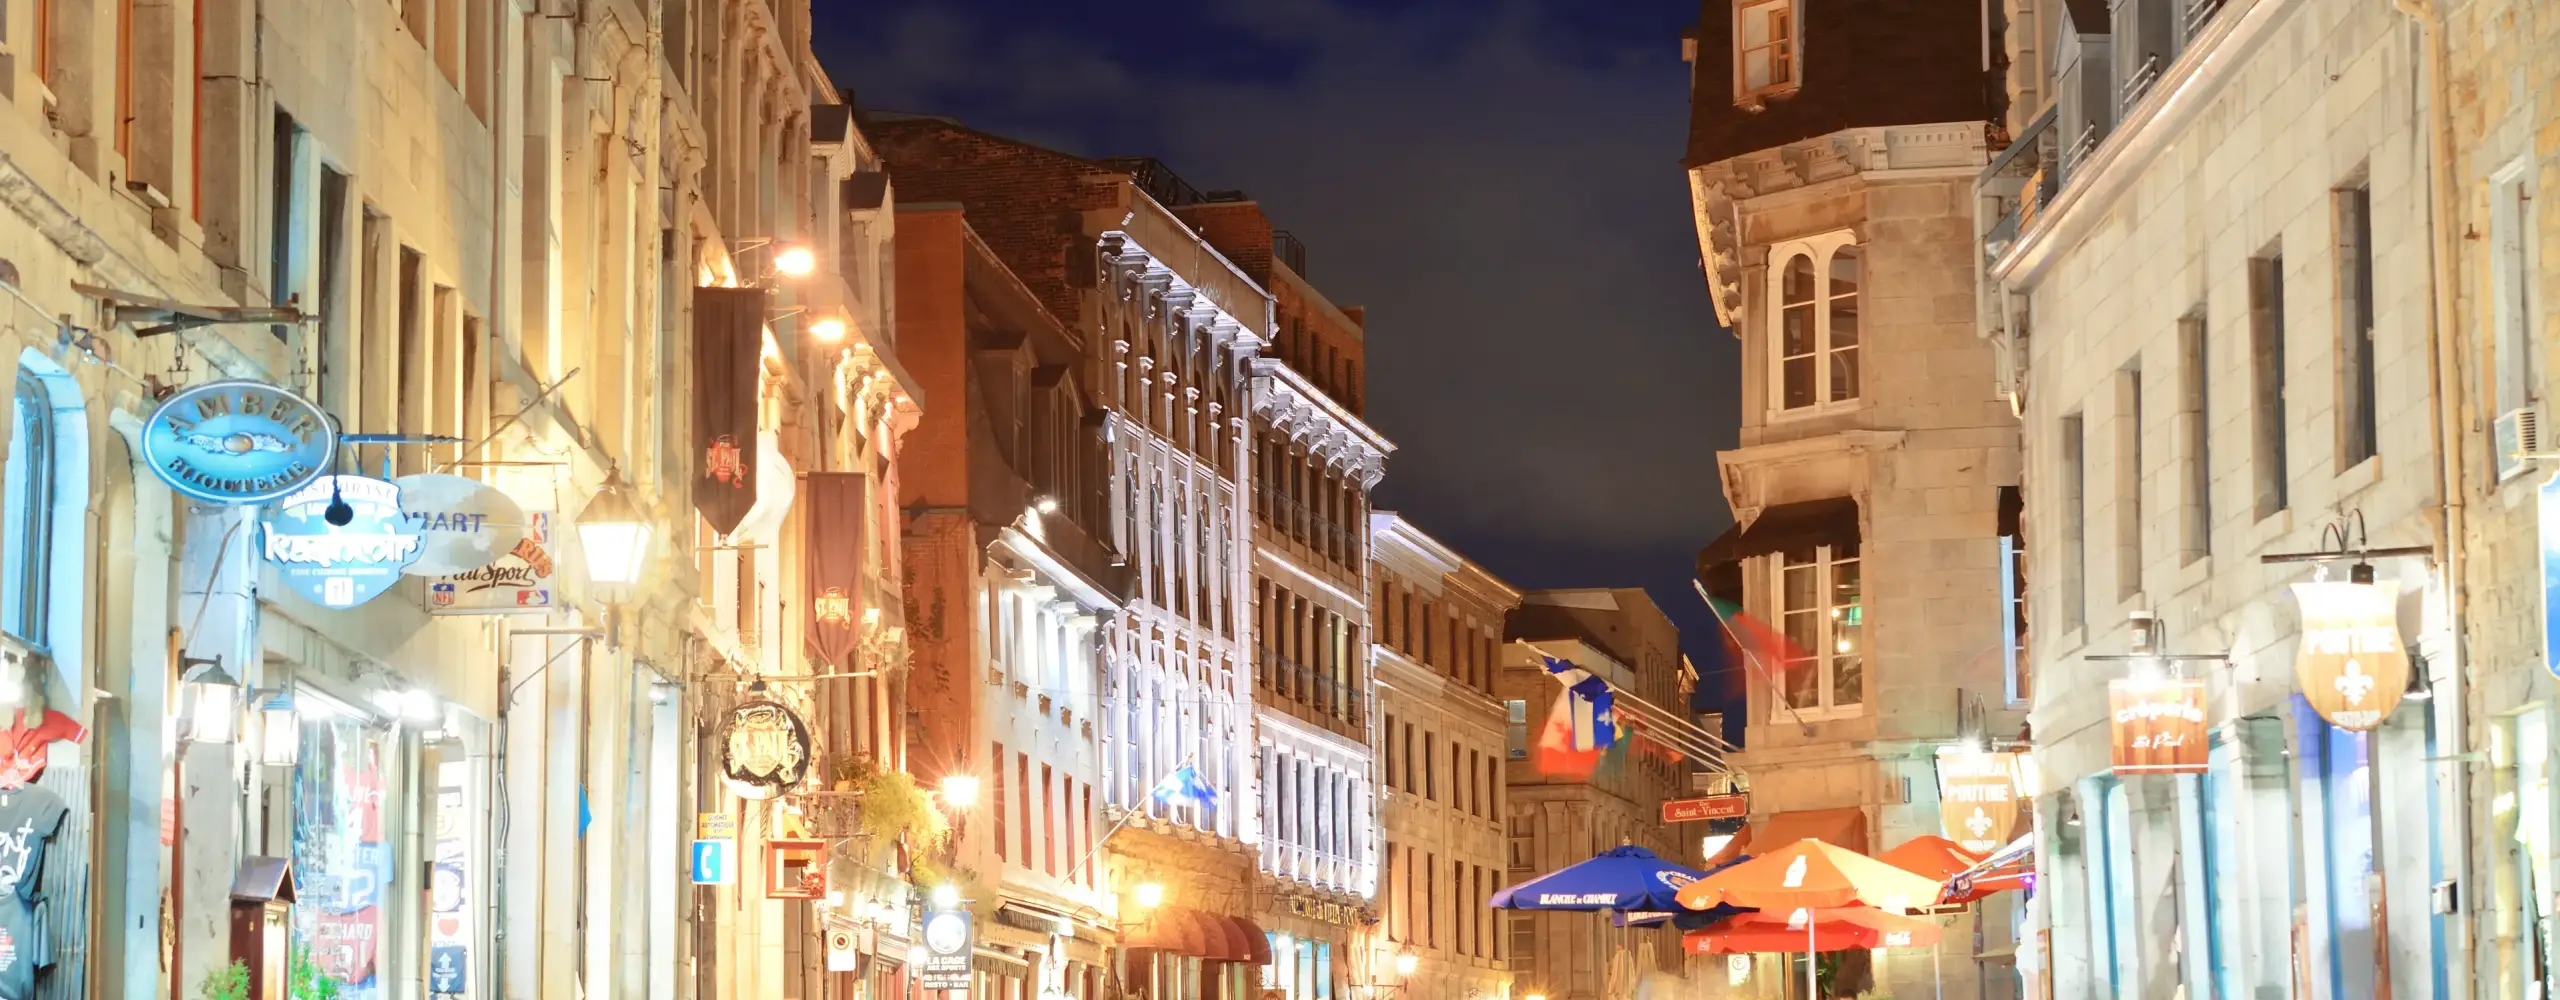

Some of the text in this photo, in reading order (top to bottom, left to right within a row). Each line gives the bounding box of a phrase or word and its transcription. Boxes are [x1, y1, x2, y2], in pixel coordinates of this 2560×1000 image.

[166, 391, 317, 443] AMBER
[168, 456, 307, 492] BIJOUTERIE
[1674, 804, 1735, 818] Saint-Vincent
